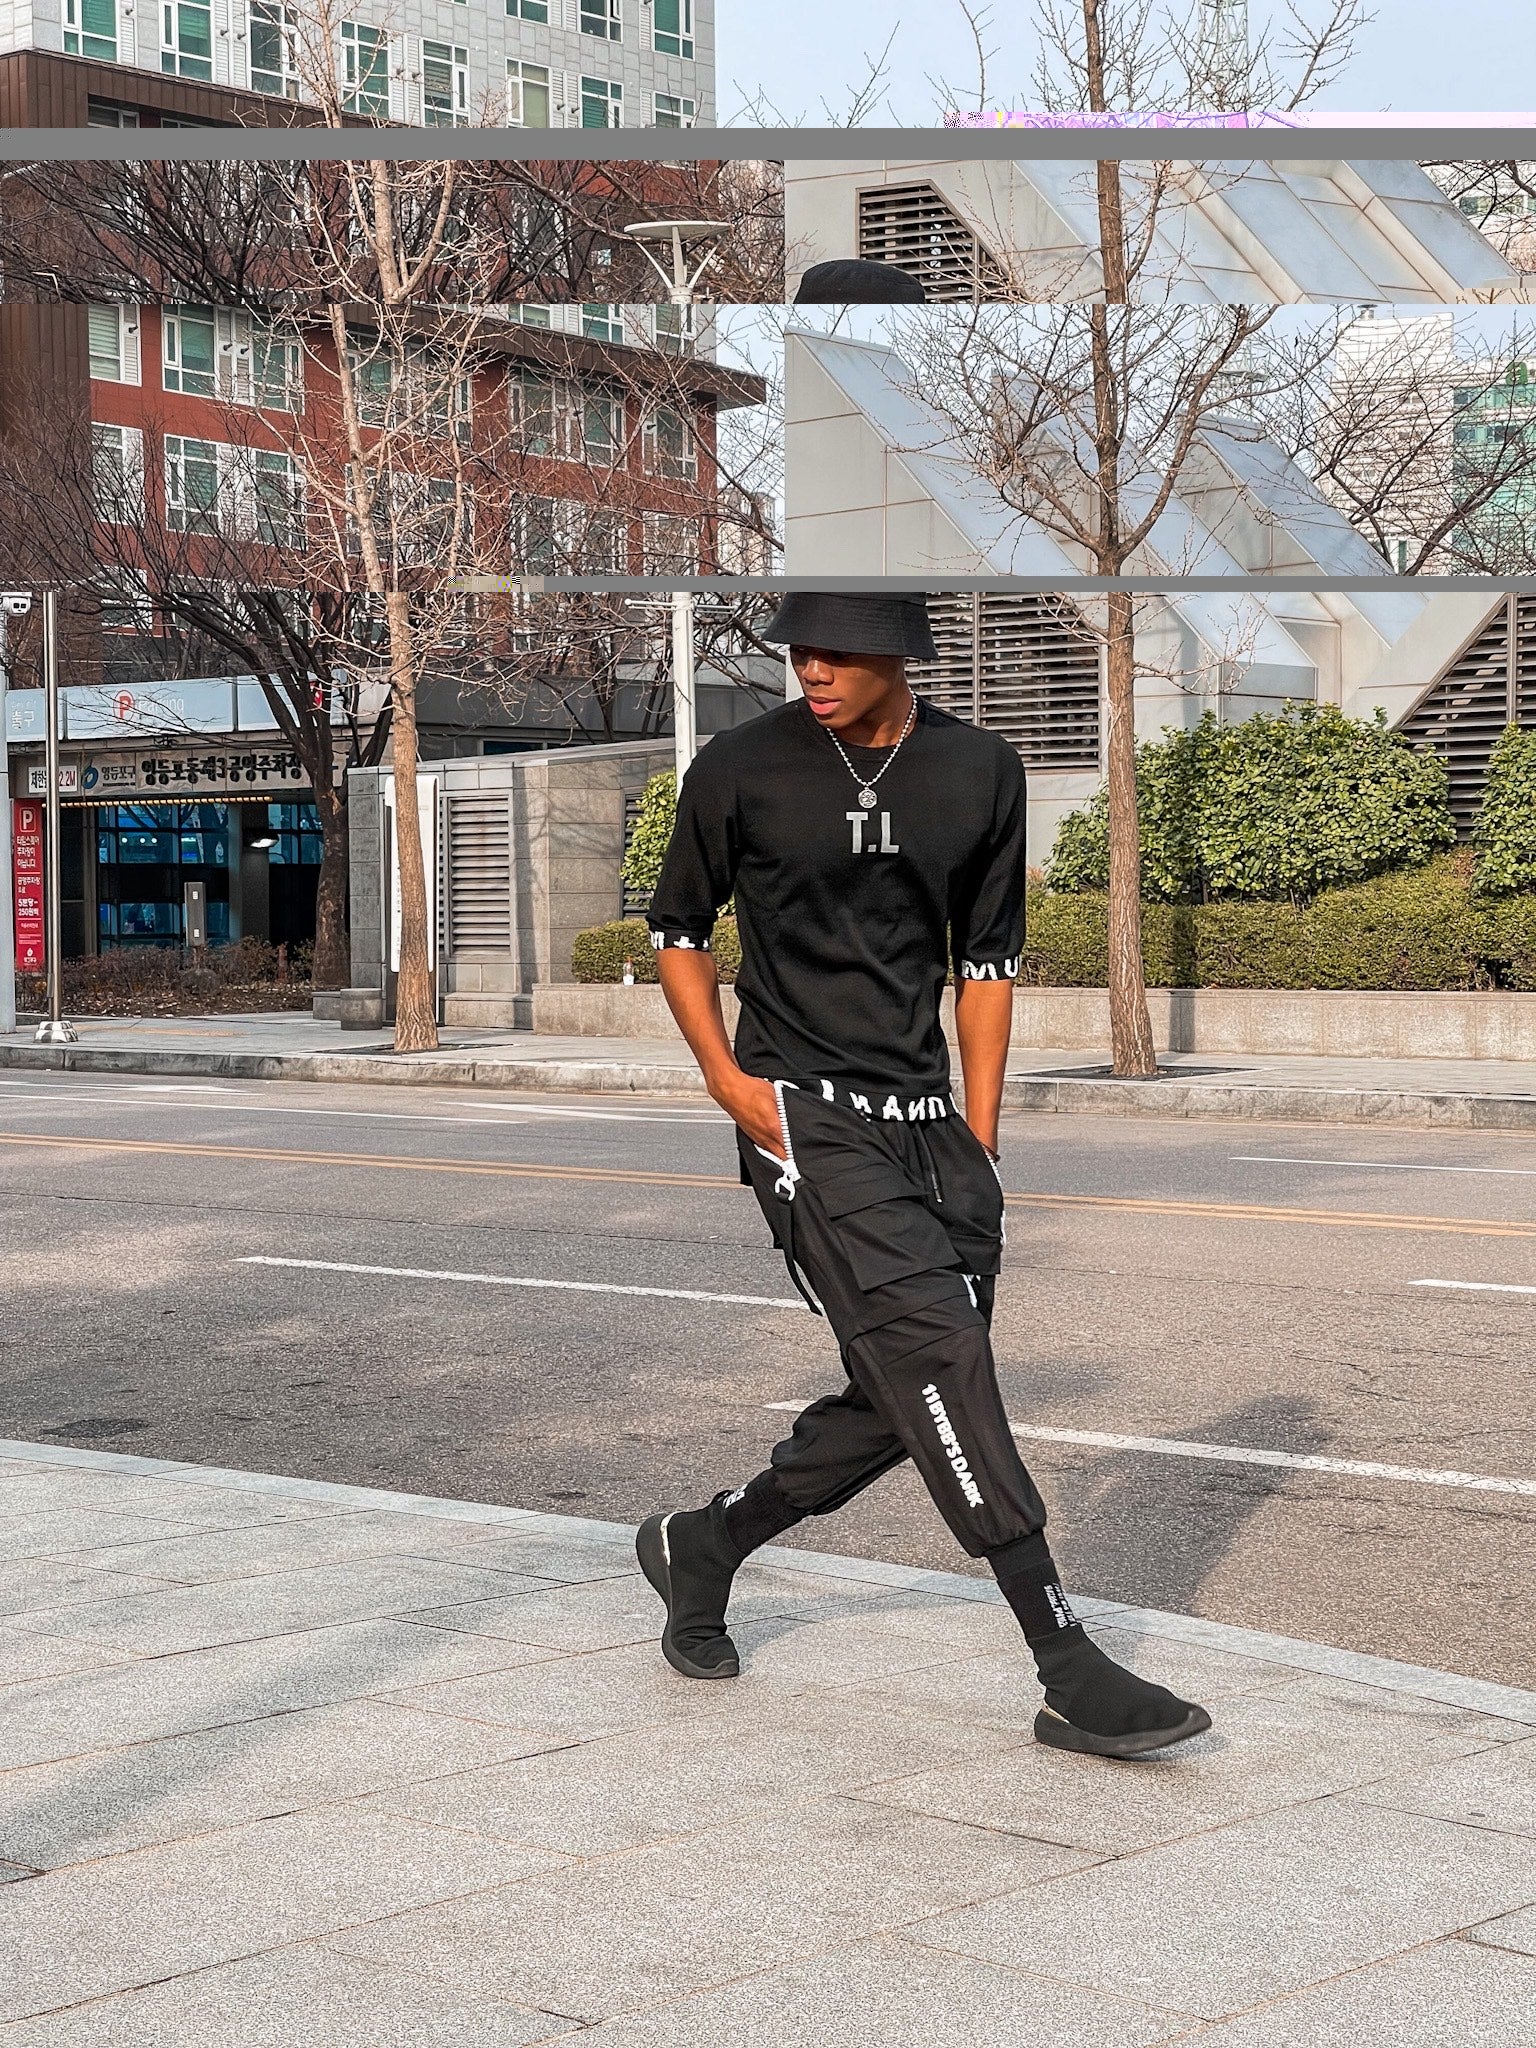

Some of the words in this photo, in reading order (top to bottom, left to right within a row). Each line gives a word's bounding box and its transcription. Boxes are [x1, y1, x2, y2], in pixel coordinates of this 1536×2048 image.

[101, 766, 136, 780] 영등포구
[23, 810, 33, 829] P
[846, 812, 900, 853] T.L
